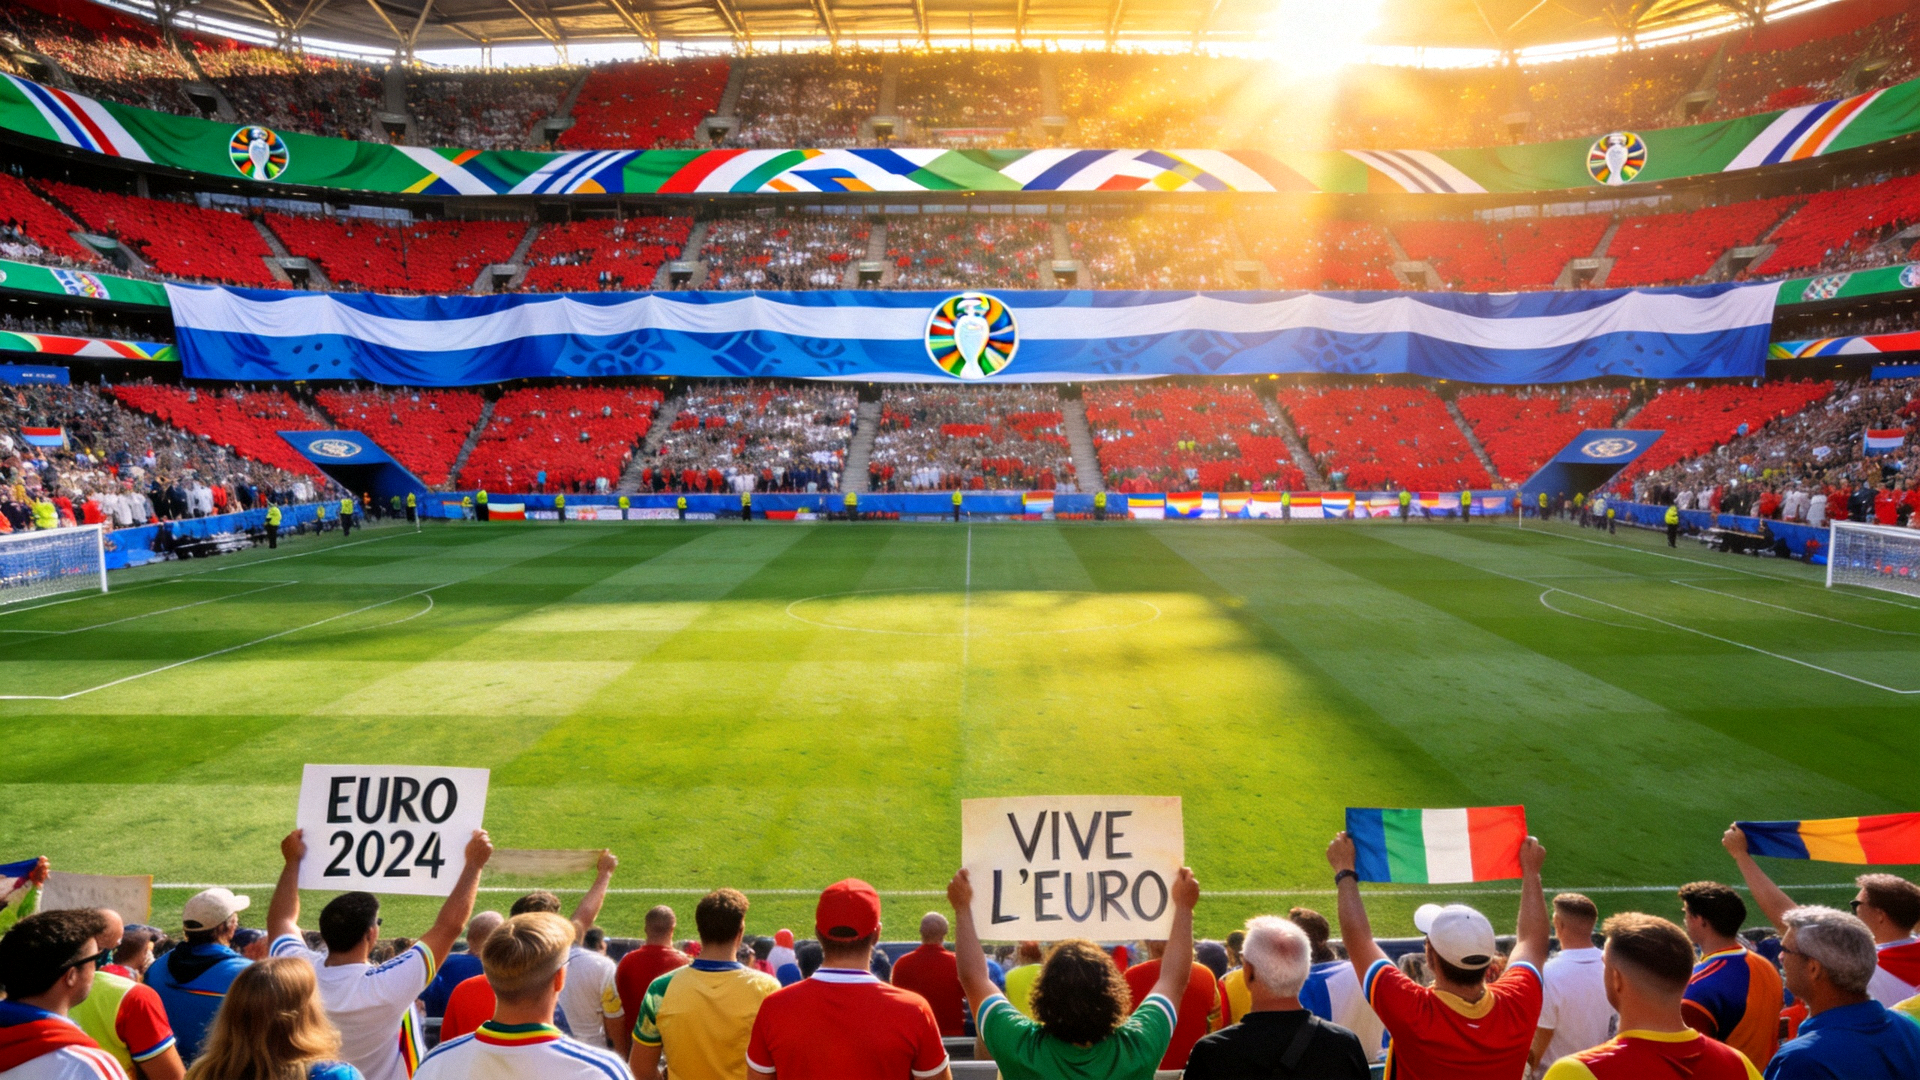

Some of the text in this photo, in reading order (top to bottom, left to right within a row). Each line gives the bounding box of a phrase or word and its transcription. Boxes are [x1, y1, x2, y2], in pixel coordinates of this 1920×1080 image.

[326, 775, 458, 824] EURO
[323, 829, 446, 879] 2024
[1007, 810, 1133, 862] VIVE
[991, 869, 1169, 924] L'EURO
